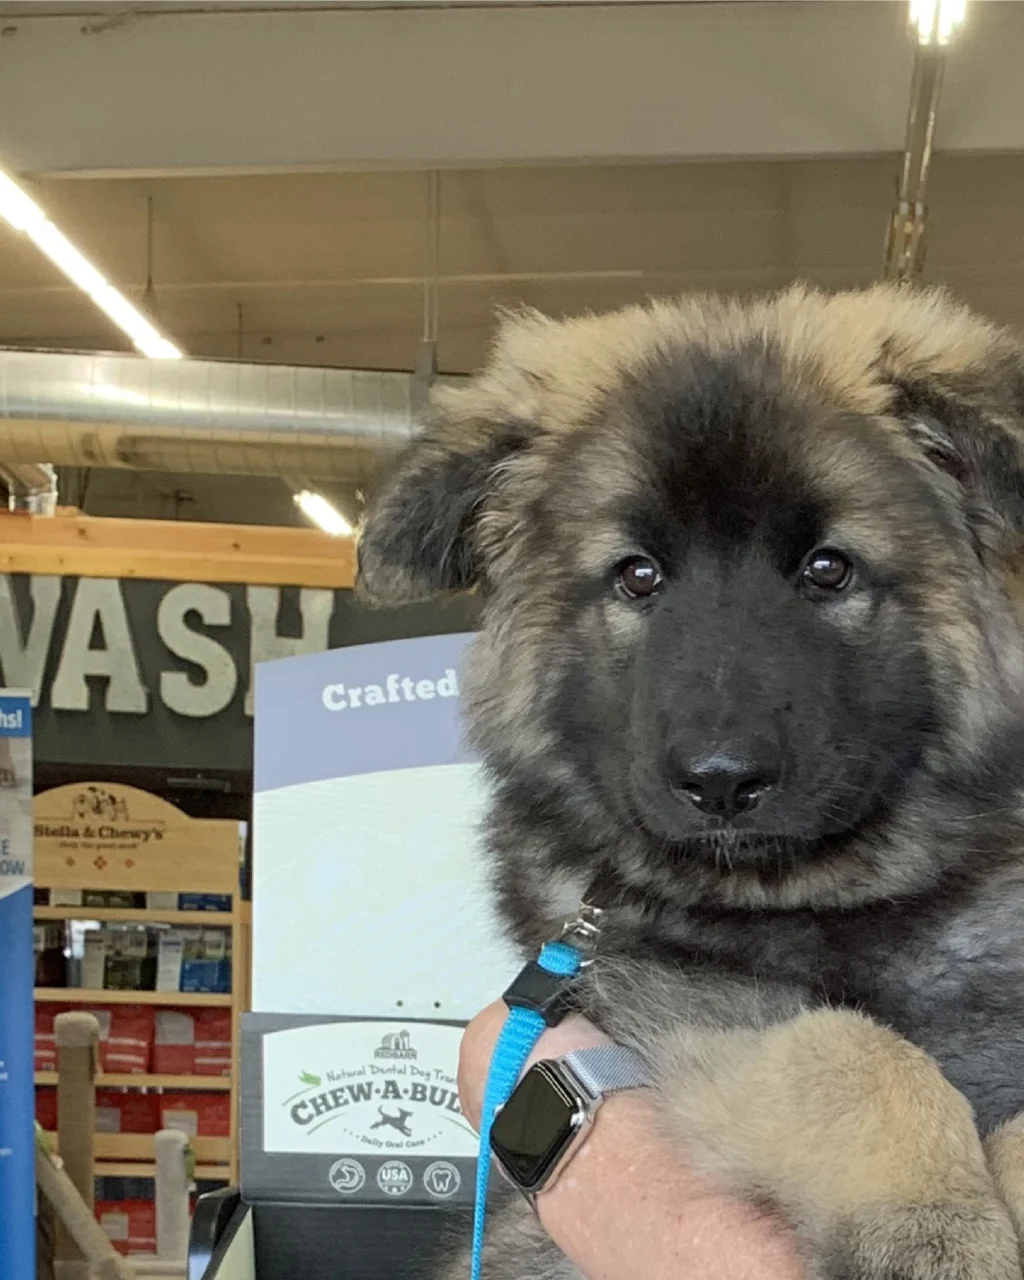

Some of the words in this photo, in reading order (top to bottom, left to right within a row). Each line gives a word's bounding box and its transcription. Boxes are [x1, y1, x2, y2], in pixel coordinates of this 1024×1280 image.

[321, 668, 460, 712] Crafted
[98, 825, 164, 843] Chewy's
[326, 1065, 366, 1083] Natural
[368, 1064, 407, 1076] Dental
[409, 1065, 431, 1082] Dog
[360, 1135, 384, 1149] Daily
[384, 1140, 404, 1148] Oral
[405, 1139, 426, 1148] Care
[381, 1168, 408, 1181] USA
